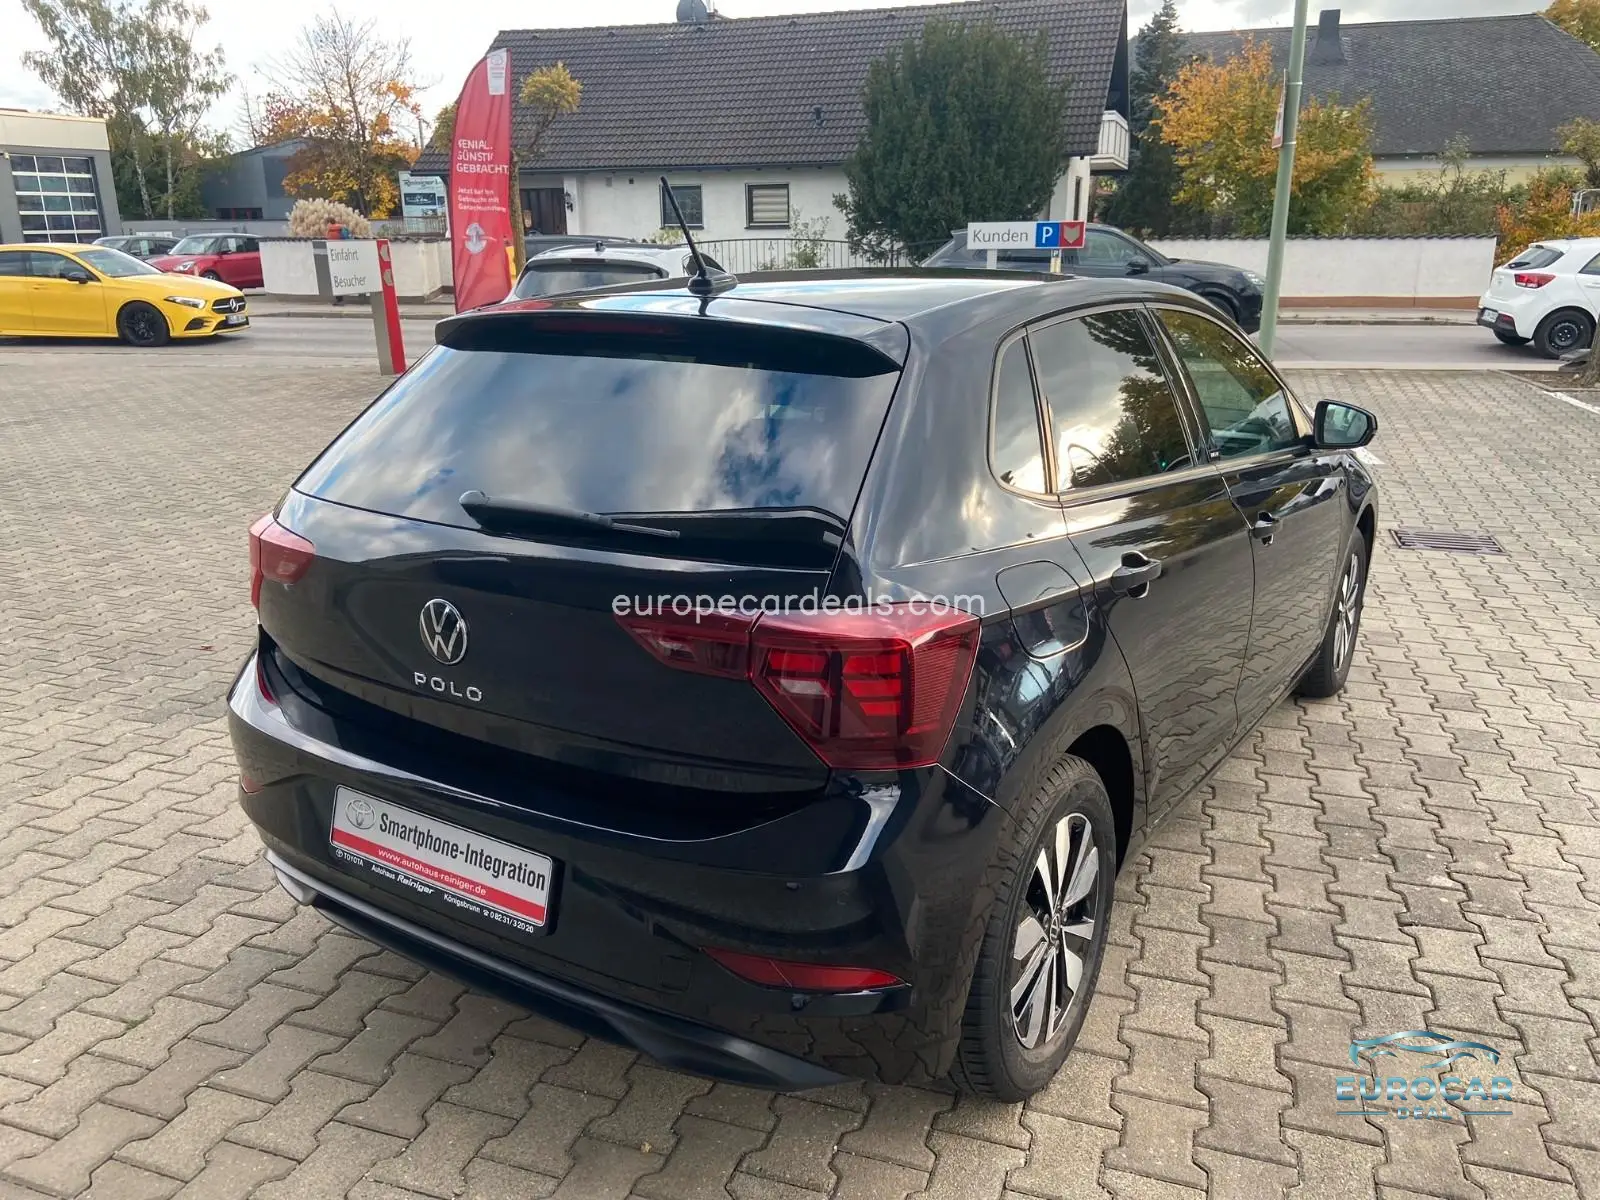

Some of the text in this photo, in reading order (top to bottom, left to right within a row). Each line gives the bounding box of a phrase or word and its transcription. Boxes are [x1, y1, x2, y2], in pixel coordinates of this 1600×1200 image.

[973, 226, 1053, 244] Kunden P
[330, 248, 359, 262] Einfahrt
[333, 275, 366, 288] Besucher
[414, 671, 483, 702] POLO
[344, 853, 364, 867] TOYOTA
[379, 812, 546, 891] Smartphone-Integration
[378, 848, 487, 896] www.autohaus-reiniger.de
[371, 864, 396, 880] Autohaus
[396, 874, 434, 895] Reiniger
[443, 893, 481, 914] Königsbrunn
